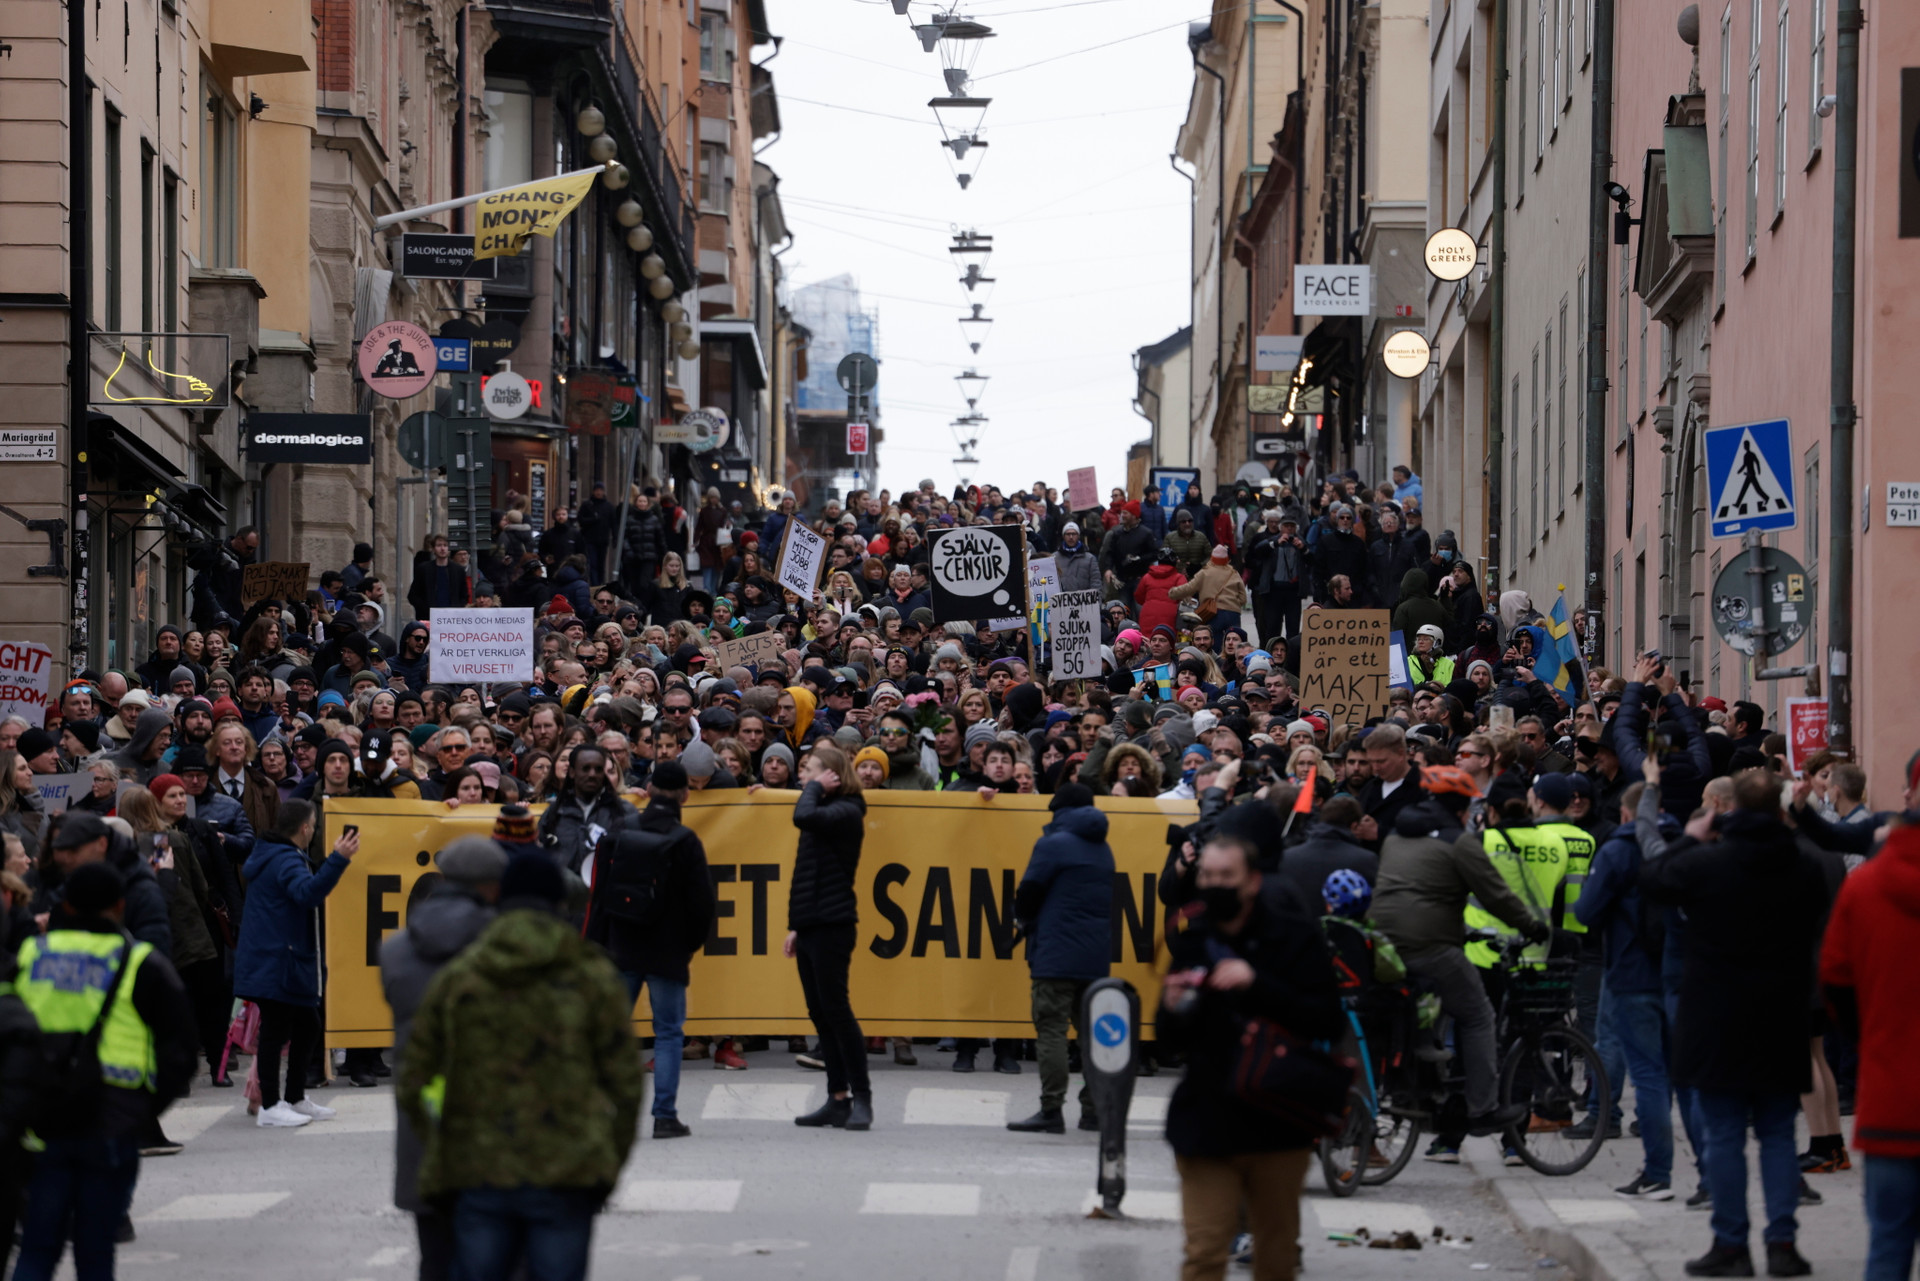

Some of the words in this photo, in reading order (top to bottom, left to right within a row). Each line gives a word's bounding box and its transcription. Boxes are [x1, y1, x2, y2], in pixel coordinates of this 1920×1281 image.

[447, 247, 475, 257] ANDR
[1438, 246, 1466, 254] HOLY
[1430, 254, 1472, 263] GREENS
[1304, 275, 1360, 297] FACE
[364, 334, 379, 353] JOE
[377, 329, 386, 339] &
[386, 325, 406, 335] THE
[406, 329, 431, 352] JUICE
[493, 338, 513, 349] söt
[437, 346, 467, 362] GE
[494, 385, 519, 397] twist
[2, 431, 54, 445] Mariagränd
[254, 432, 364, 447] dermalogica
[36, 448, 54, 458] 4-2
[1890, 486, 1919, 500] Pete
[1890, 508, 1918, 522] 9-11
[791, 540, 813, 560] MITT
[941, 533, 1002, 556] SJÄLV-
[790, 550, 810, 571] JOBB
[934, 555, 1006, 583] -CENSUR
[1051, 591, 1100, 609] SVENSKARNA
[436, 617, 473, 625] STATENS
[474, 617, 493, 625] OCH
[494, 616, 526, 625] MEDIAS
[1068, 607, 1080, 620] ÄR
[1059, 621, 1091, 635] SJUKA
[1307, 613, 1389, 631] Corona-
[439, 632, 524, 643] PROPAGANDA
[1055, 636, 1091, 652] STOPPA
[1308, 633, 1385, 653] pandemin
[440, 647, 454, 658] ÄR
[456, 648, 476, 658] DET
[478, 648, 527, 657] VERKLIGA
[726, 635, 772, 658] FACTS
[0, 643, 53, 674] GHT
[740, 652, 758, 662] NOT
[1063, 652, 1084, 675] 5G
[1314, 651, 1337, 669] är
[1348, 651, 1379, 667] ett
[452, 663, 514, 675] VIRUSET!!
[14, 674, 37, 686] your
[1302, 673, 1390, 702] MAKT-
[7, 703, 18, 714] &
[702, 862, 780, 957] ET
[869, 862, 1158, 964] SANN
